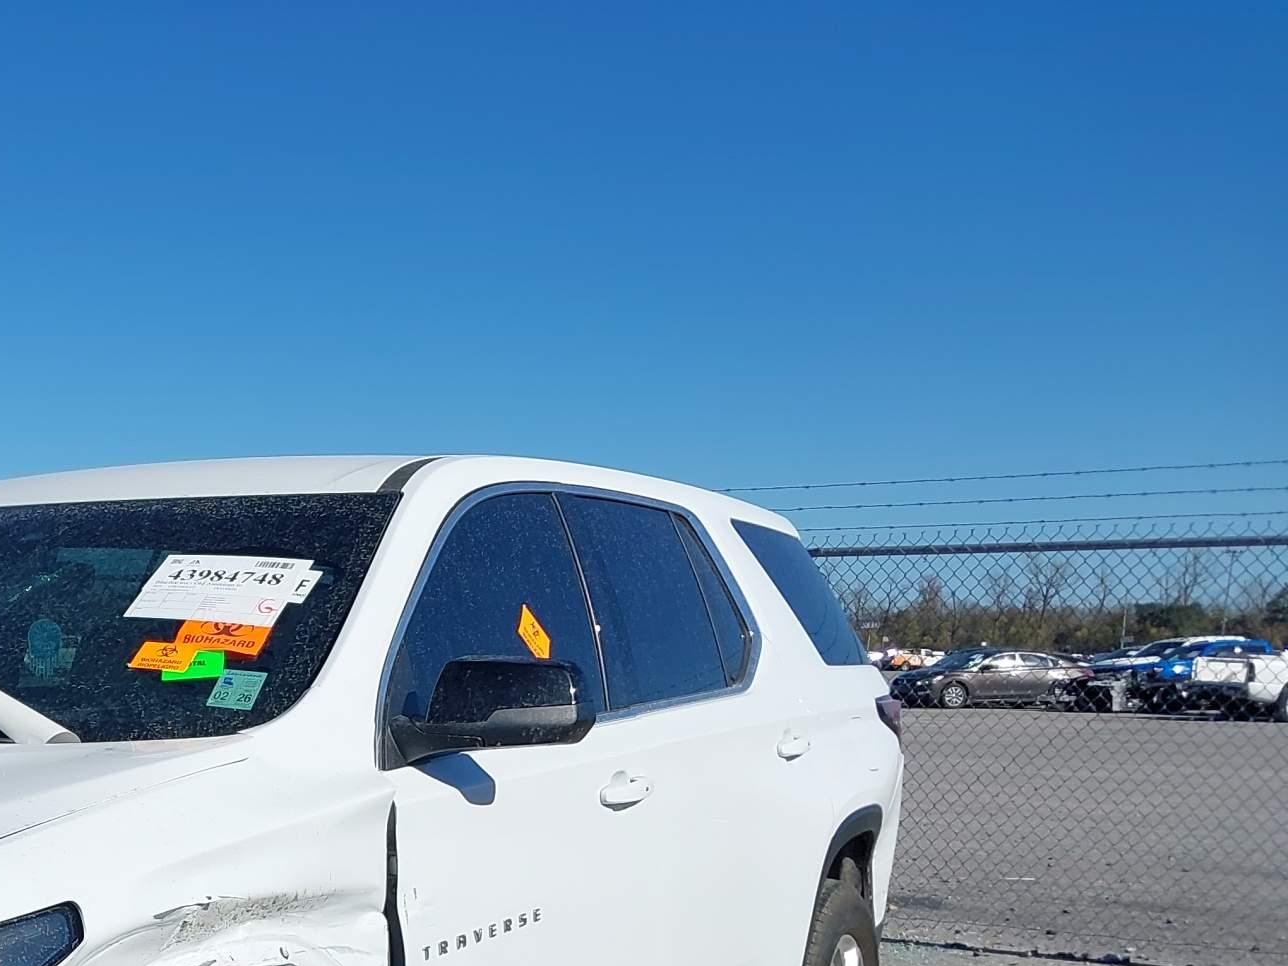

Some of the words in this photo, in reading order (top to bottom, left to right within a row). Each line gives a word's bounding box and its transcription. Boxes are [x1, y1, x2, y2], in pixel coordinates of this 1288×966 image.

[168, 568, 284, 586] 43984748
[295, 579, 310, 592] F
[183, 634, 256, 649] BIOHAZARD
[213, 691, 229, 701] 02
[236, 693, 253, 703] 26
[422, 908, 541, 961] TRAVERSE
